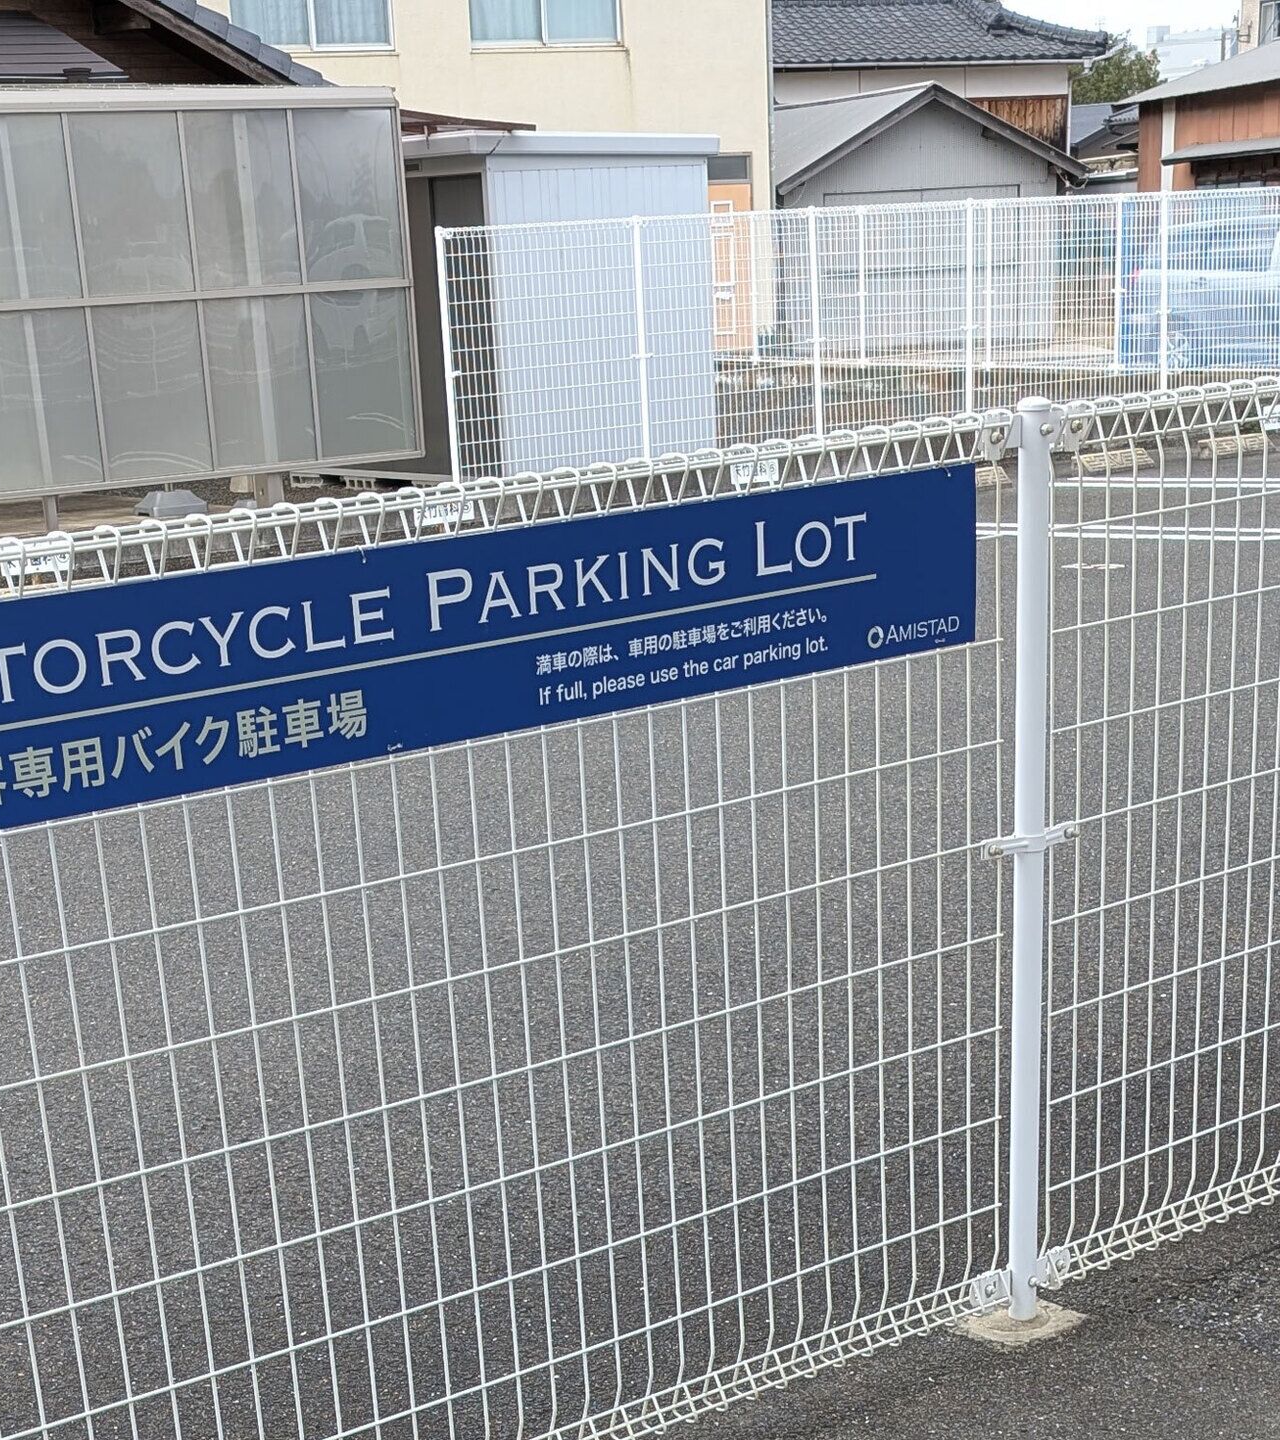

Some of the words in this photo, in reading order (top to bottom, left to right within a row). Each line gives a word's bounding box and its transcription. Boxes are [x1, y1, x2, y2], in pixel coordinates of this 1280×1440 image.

[425, 537, 726, 632] PARKING
[754, 511, 868, 577] LOT
[885, 615, 960, 645] AMISTAD
[538, 686, 551, 706] If
[556, 681, 587, 702] full,
[592, 673, 645, 699] please
[650, 666, 678, 684] use
[682, 659, 709, 677] the
[713, 654, 739, 672] car
[743, 642, 801, 669] parking
[805, 636, 828, 654] lot.
